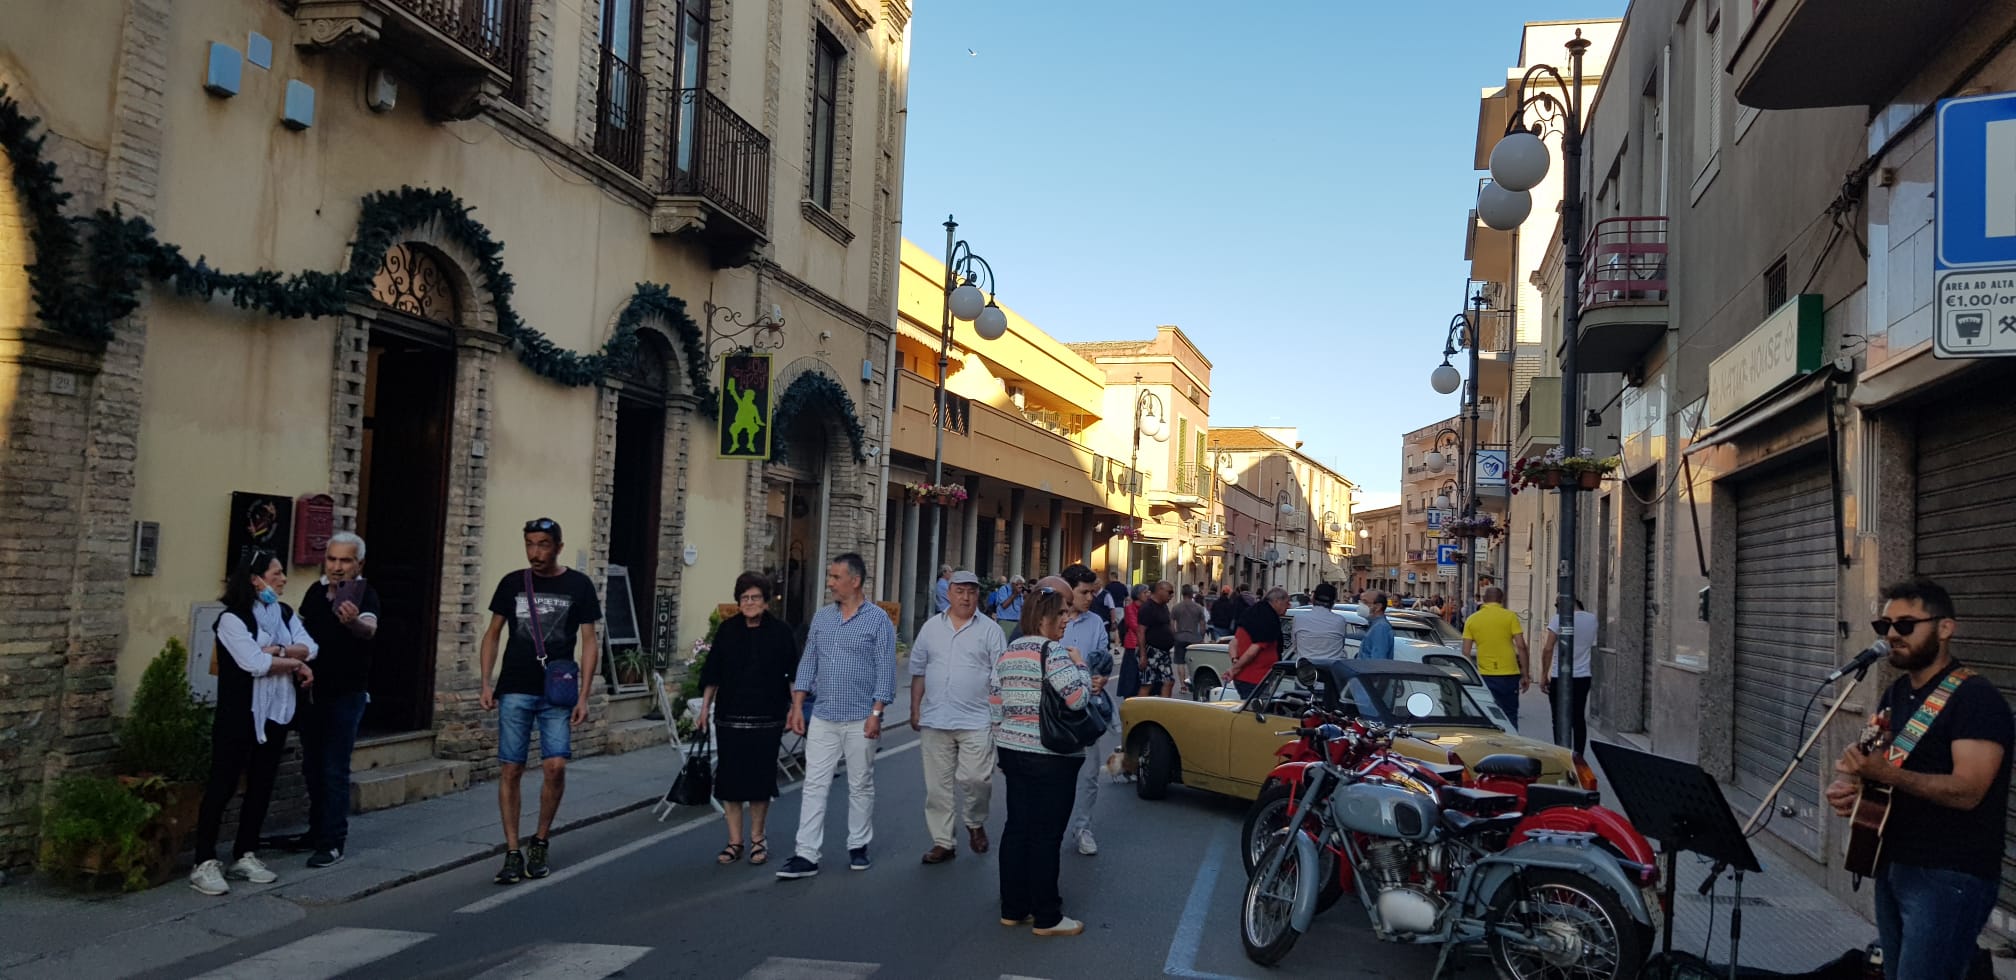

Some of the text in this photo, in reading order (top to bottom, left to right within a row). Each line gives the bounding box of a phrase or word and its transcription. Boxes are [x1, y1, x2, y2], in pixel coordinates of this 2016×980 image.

[1945, 280, 2014, 291] AREA AD ALTA
[1441, 548, 1459, 562] P
[657, 612, 669, 662] OPEN
